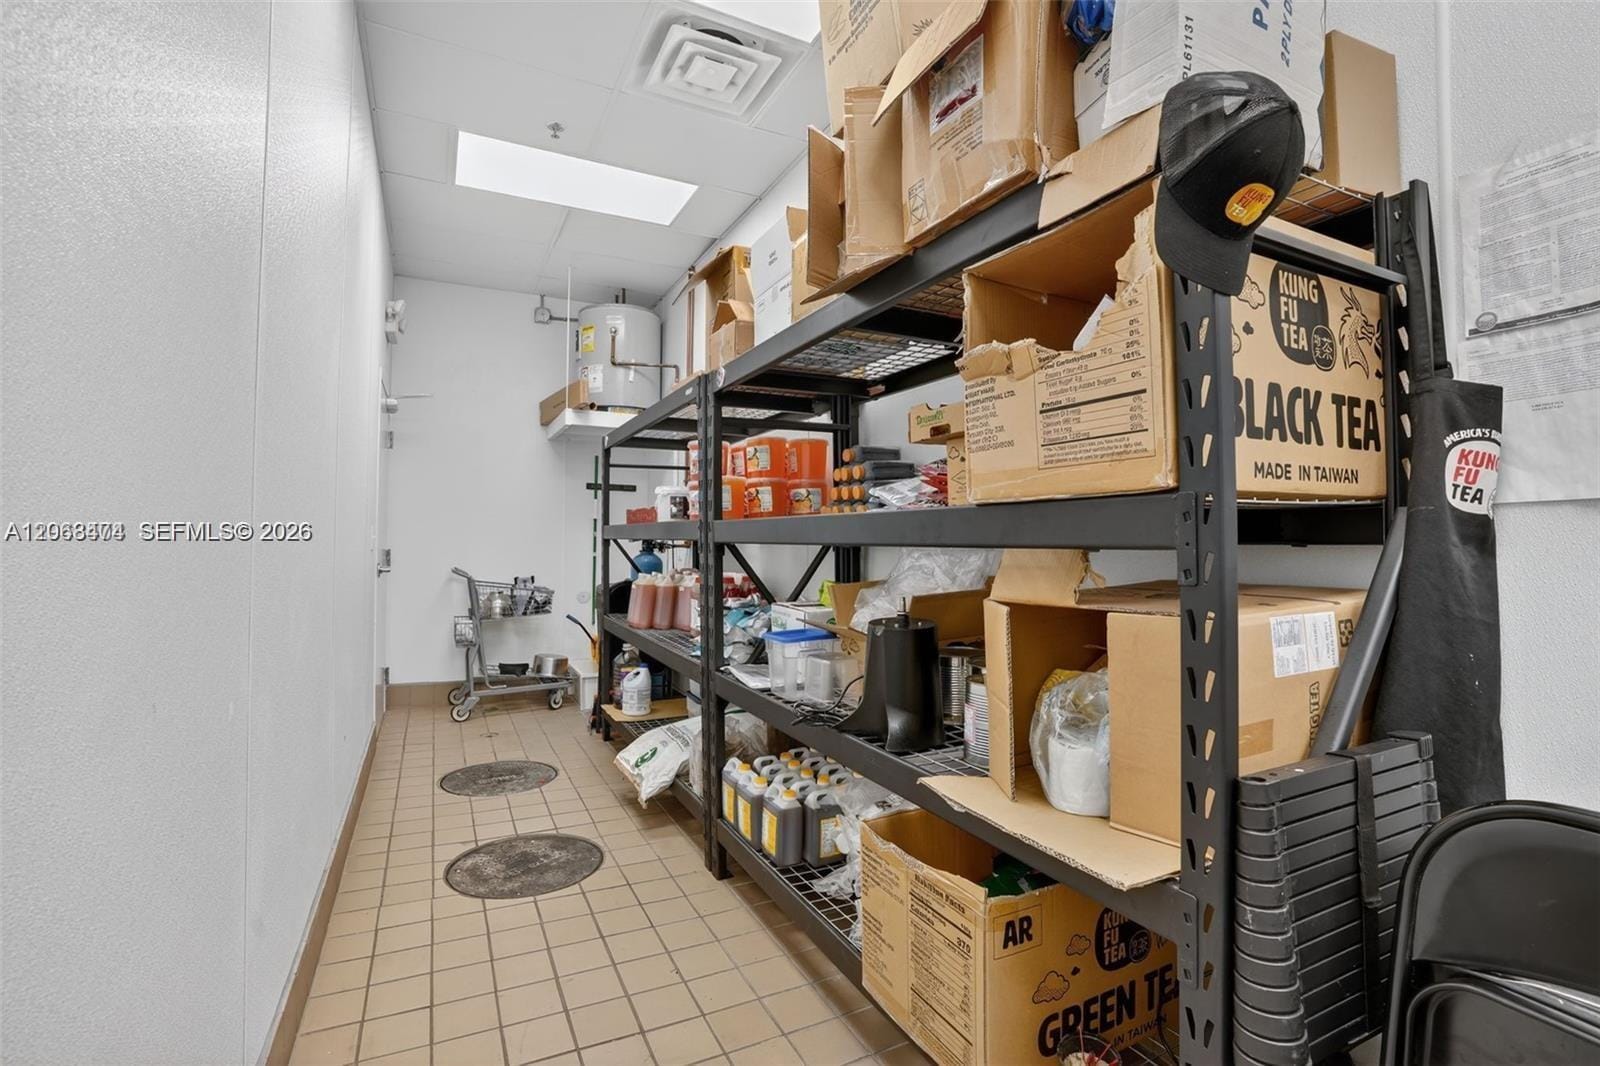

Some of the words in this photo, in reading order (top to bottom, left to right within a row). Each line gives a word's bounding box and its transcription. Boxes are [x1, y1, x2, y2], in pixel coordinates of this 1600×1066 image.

[1278, 269, 1318, 304] KUNG
[1279, 296, 1298, 323] FU
[1280, 321, 1308, 351] TEA
[1331, 392, 1381, 452] TEA
[1253, 461, 1292, 481] MADE
[1298, 464, 1311, 482] IN
[1314, 466, 1359, 484] TAIWAN
[1453, 466, 1480, 486] FU
[1450, 483, 1485, 505] TEA
[1002, 915, 1033, 950] AR
[1103, 926, 1120, 948] FU
[1103, 942, 1127, 966] TEA
[1037, 979, 1136, 1058] GREEN
[1112, 1034, 1124, 1047] IN
